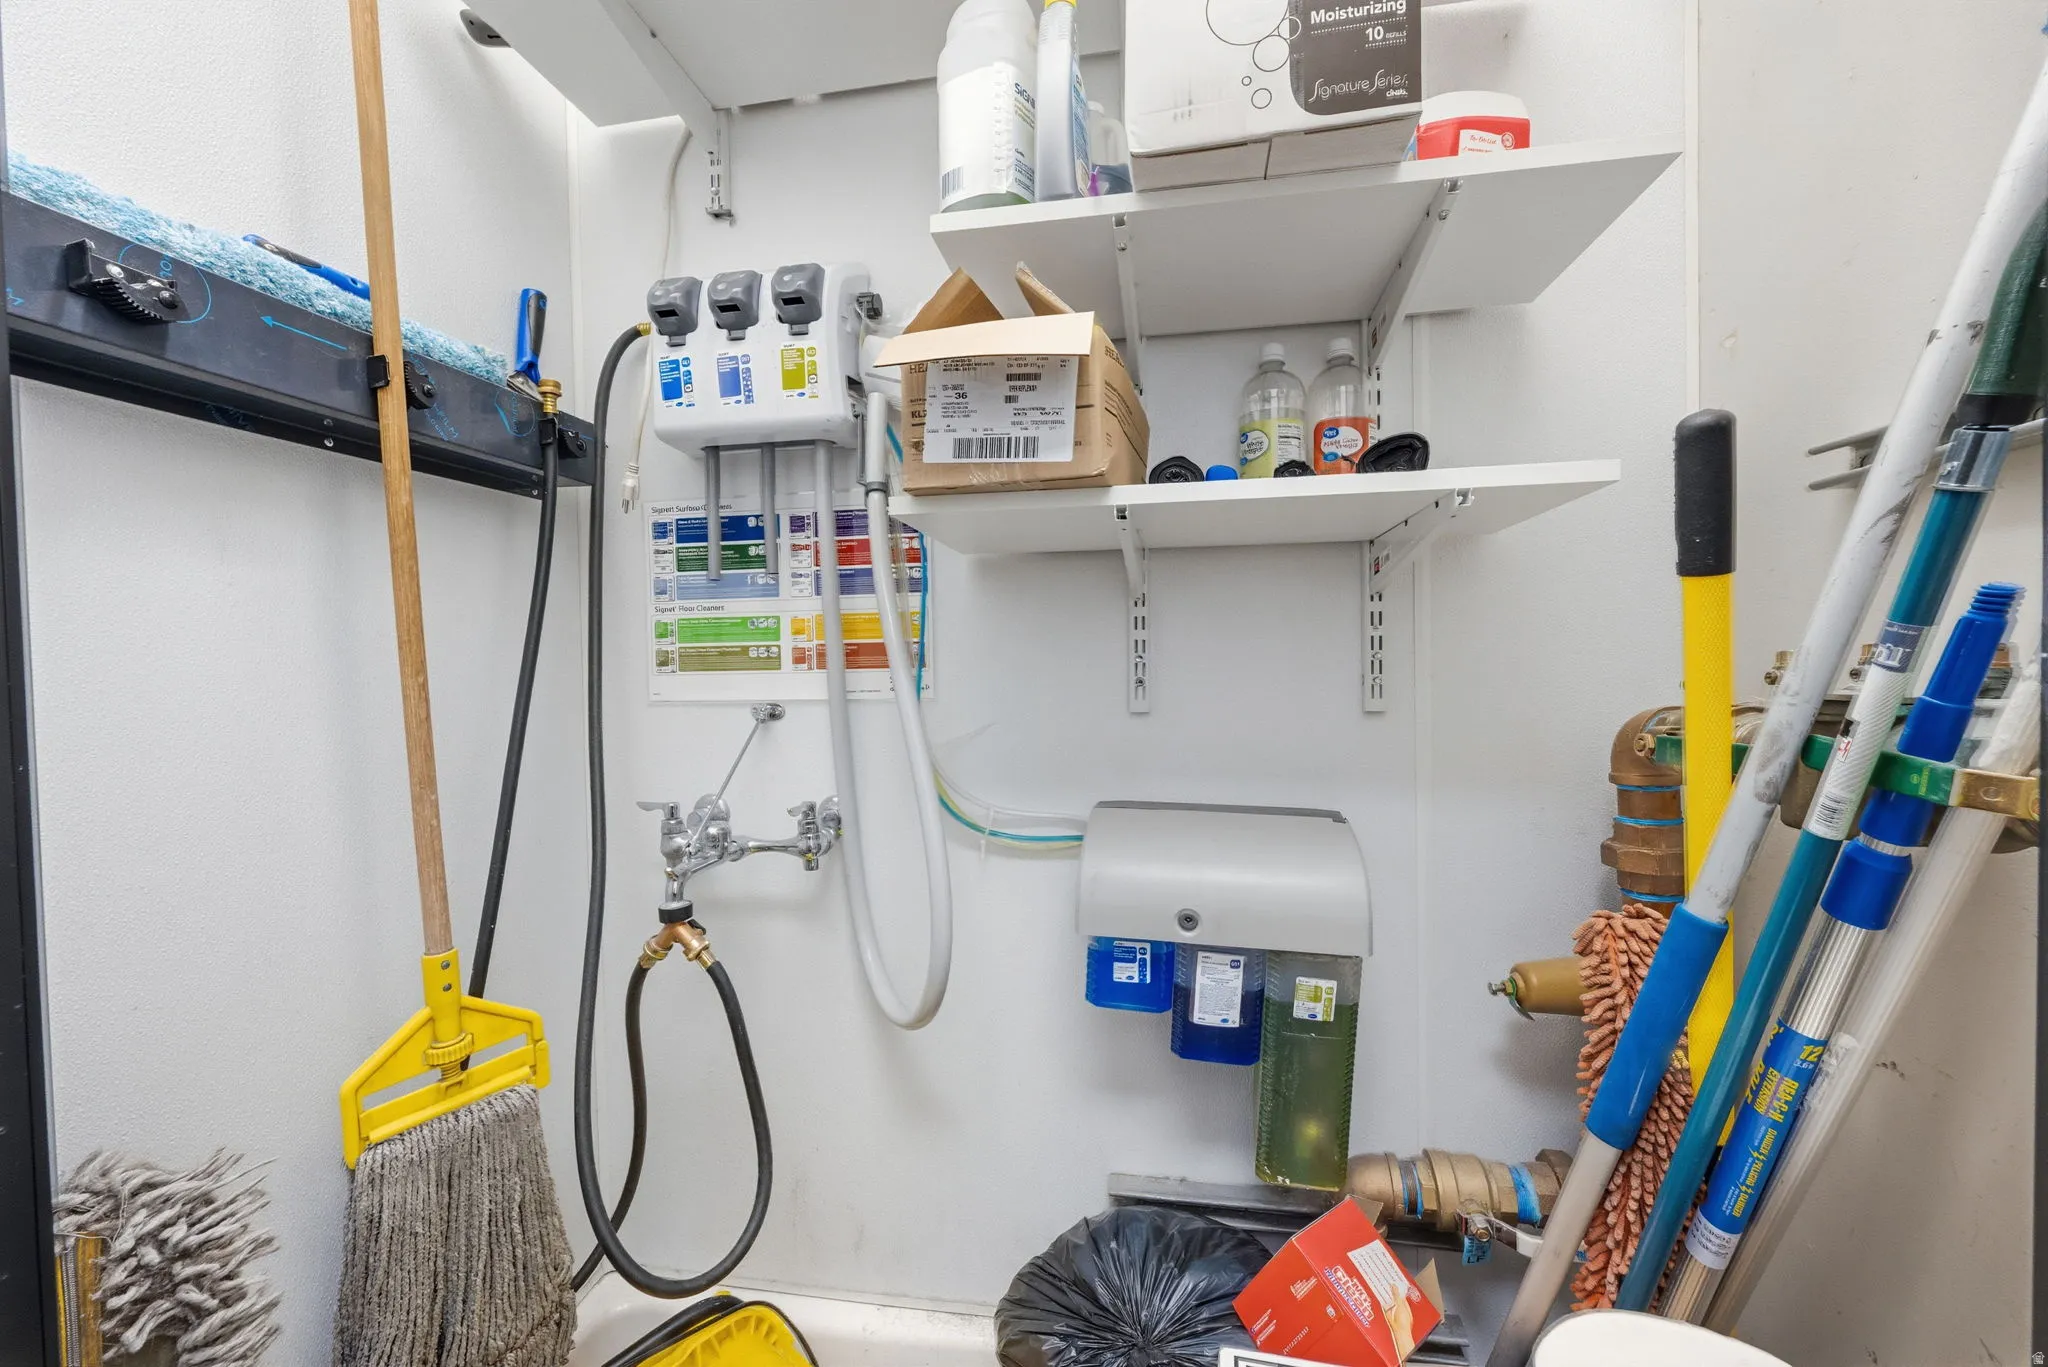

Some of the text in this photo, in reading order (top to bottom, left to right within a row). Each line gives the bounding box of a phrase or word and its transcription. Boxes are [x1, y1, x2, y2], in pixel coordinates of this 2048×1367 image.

[1310, 0, 1407, 25] Moisturizing
[1365, 26, 1385, 41] 10
[1308, 69, 1408, 102] Signature Series
[954, 391, 968, 400] 36
[678, 604, 695, 612] Floor
[696, 604, 725, 612] Cleaners
[1799, 1045, 1824, 1062] 12
